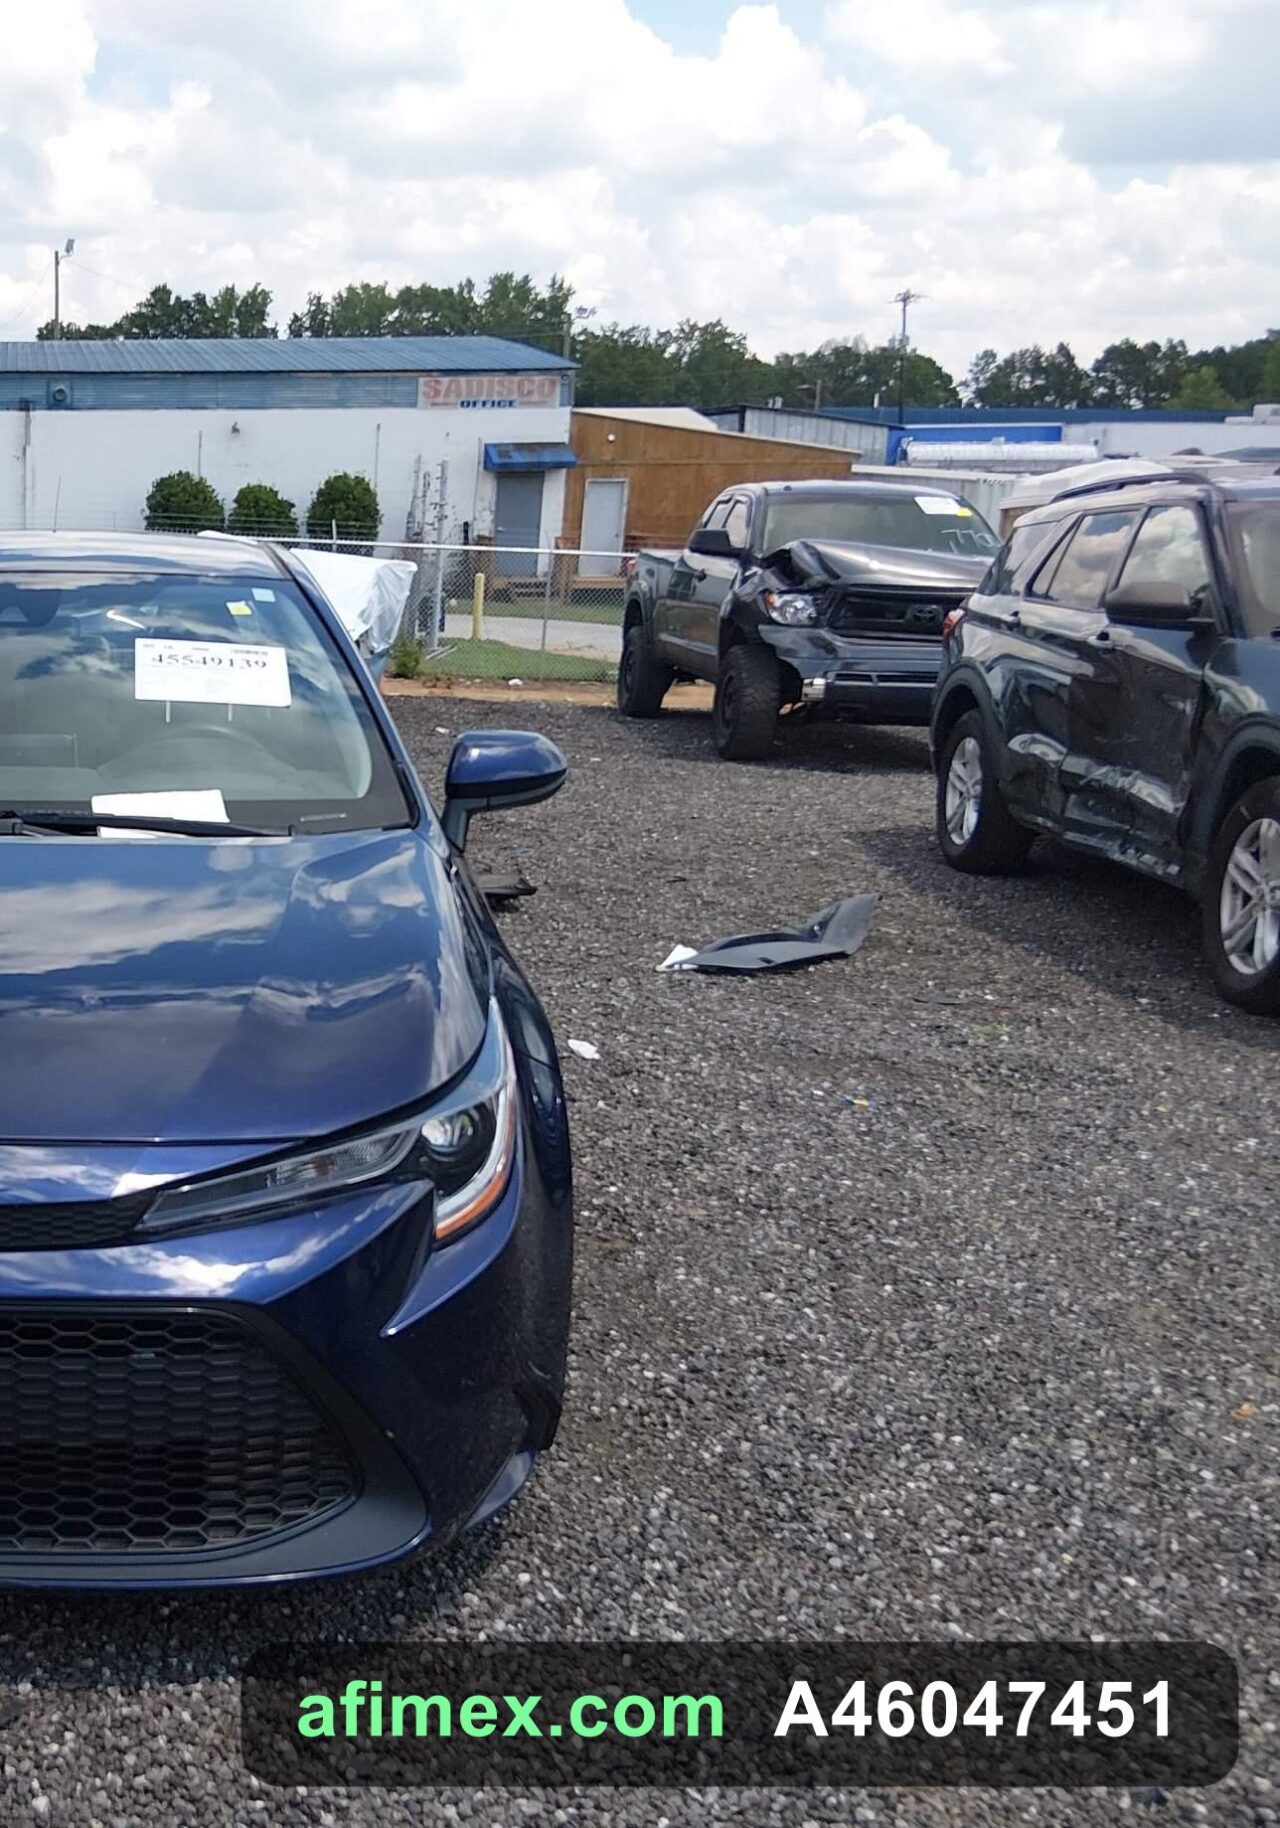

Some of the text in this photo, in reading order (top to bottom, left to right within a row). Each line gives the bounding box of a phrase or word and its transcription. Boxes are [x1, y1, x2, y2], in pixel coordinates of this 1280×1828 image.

[423, 377, 557, 400] SADISCO
[460, 400, 516, 408] OFFICE
[152, 653, 267, 669] 45549139
